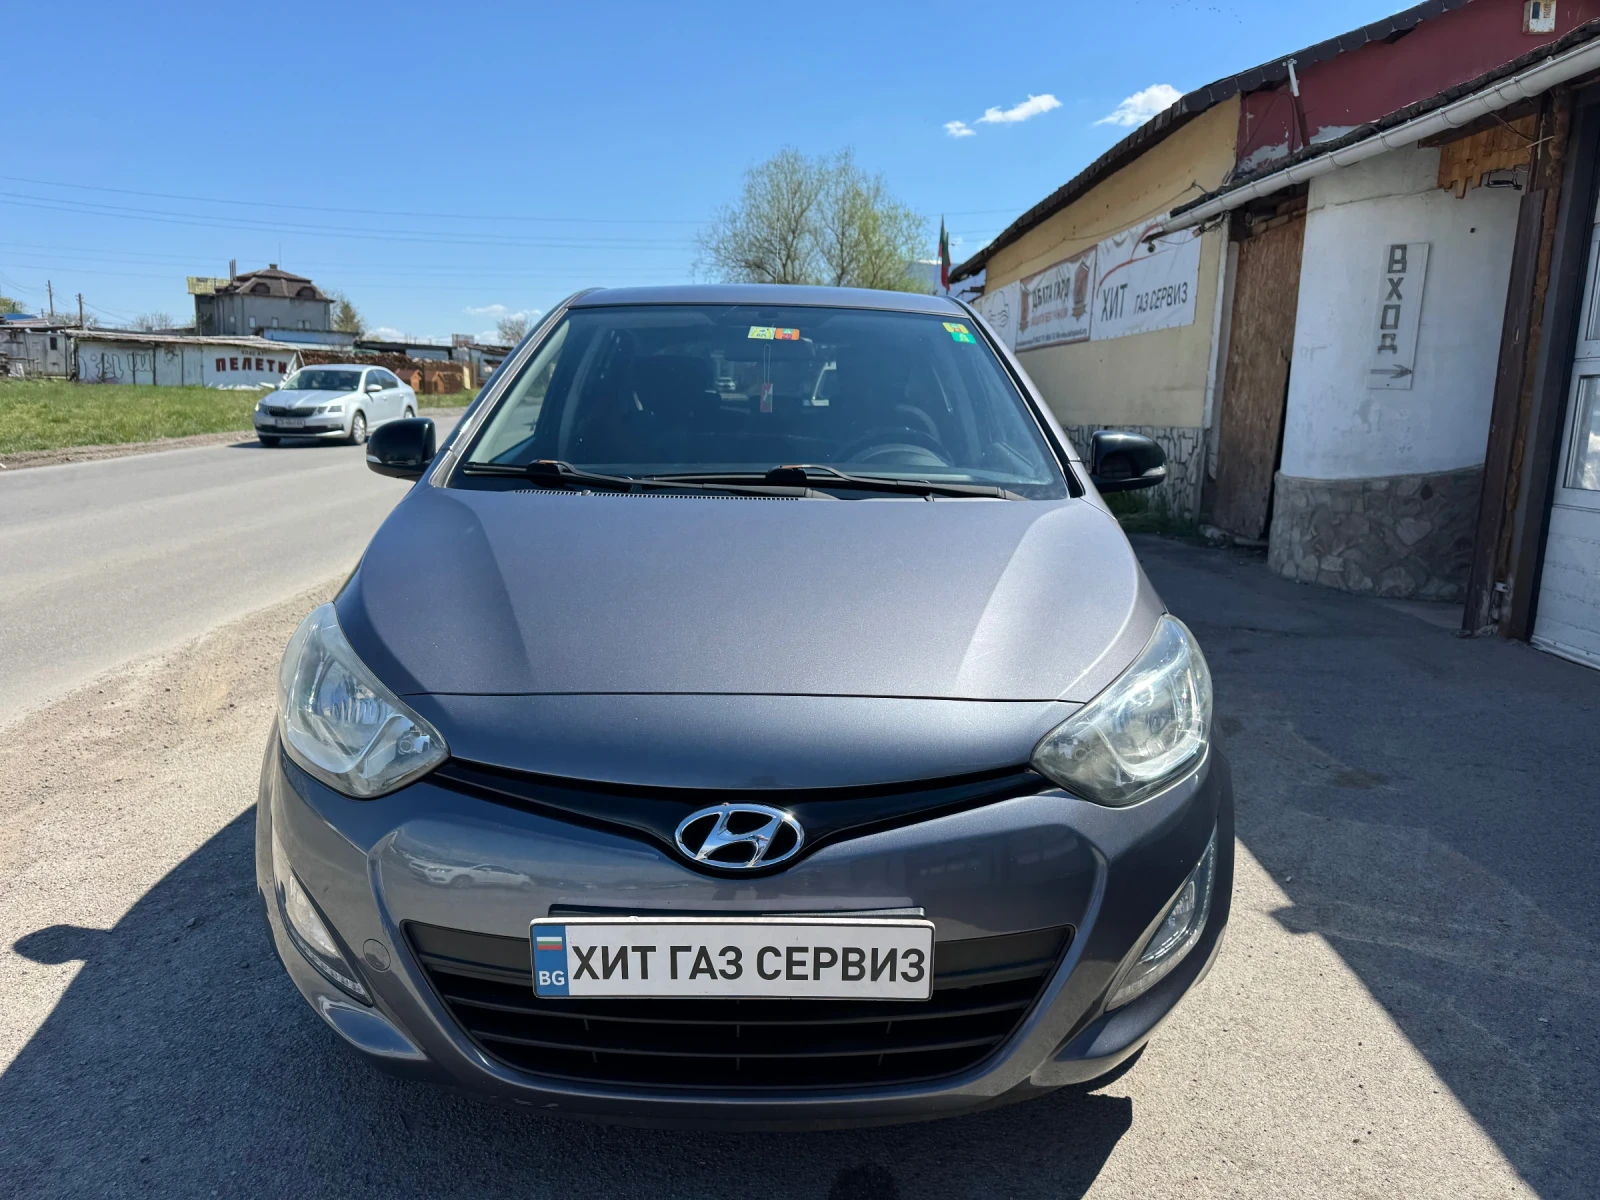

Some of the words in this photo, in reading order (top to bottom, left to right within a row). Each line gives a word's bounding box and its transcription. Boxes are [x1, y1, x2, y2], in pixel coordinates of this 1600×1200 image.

[1101, 283, 1128, 322] ХИТ
[1133, 292, 1149, 315] ГАЗ
[1149, 281, 1188, 311] СЕРВИЗ
[1377, 244, 1408, 355] ВХОД
[215, 357, 287, 374] ПЕЛЕТИ
[538, 970, 565, 986] BG
[572, 945, 656, 980] ХИТ
[669, 945, 743, 980] ГАЗ
[756, 946, 925, 983] СЕРВИЗ
